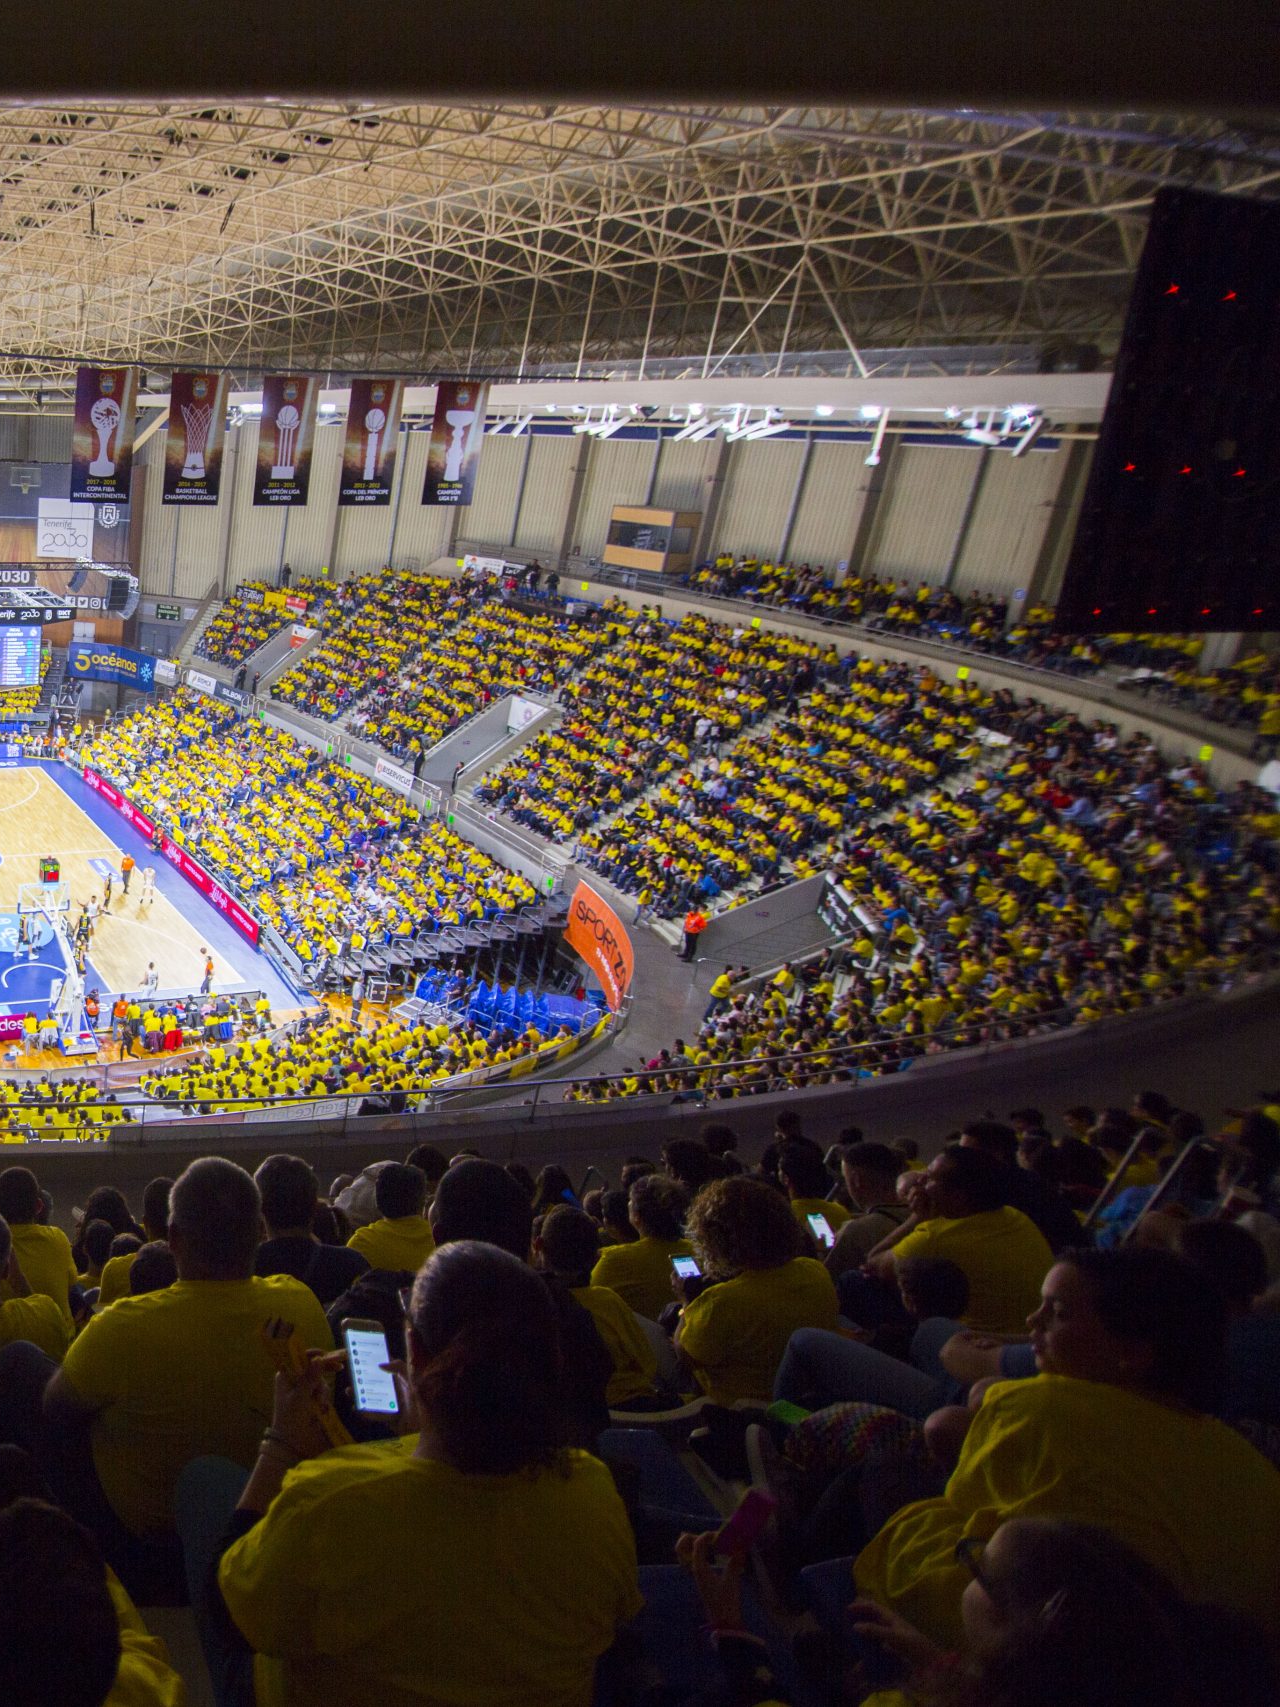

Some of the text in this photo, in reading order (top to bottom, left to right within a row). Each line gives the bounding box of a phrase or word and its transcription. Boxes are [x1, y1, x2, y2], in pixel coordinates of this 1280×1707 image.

[73, 492, 127, 500] INTERCONTINENTAL
[262, 487, 287, 495] CAMPEÓN
[437, 488, 461, 496] CAMPEÓN
[43, 519, 73, 528] Tenerife
[42, 528, 88, 551] 2030
[21, 608, 40, 620] 2030
[91, 652, 137, 673] océanos
[576, 900, 618, 959] SPORT
